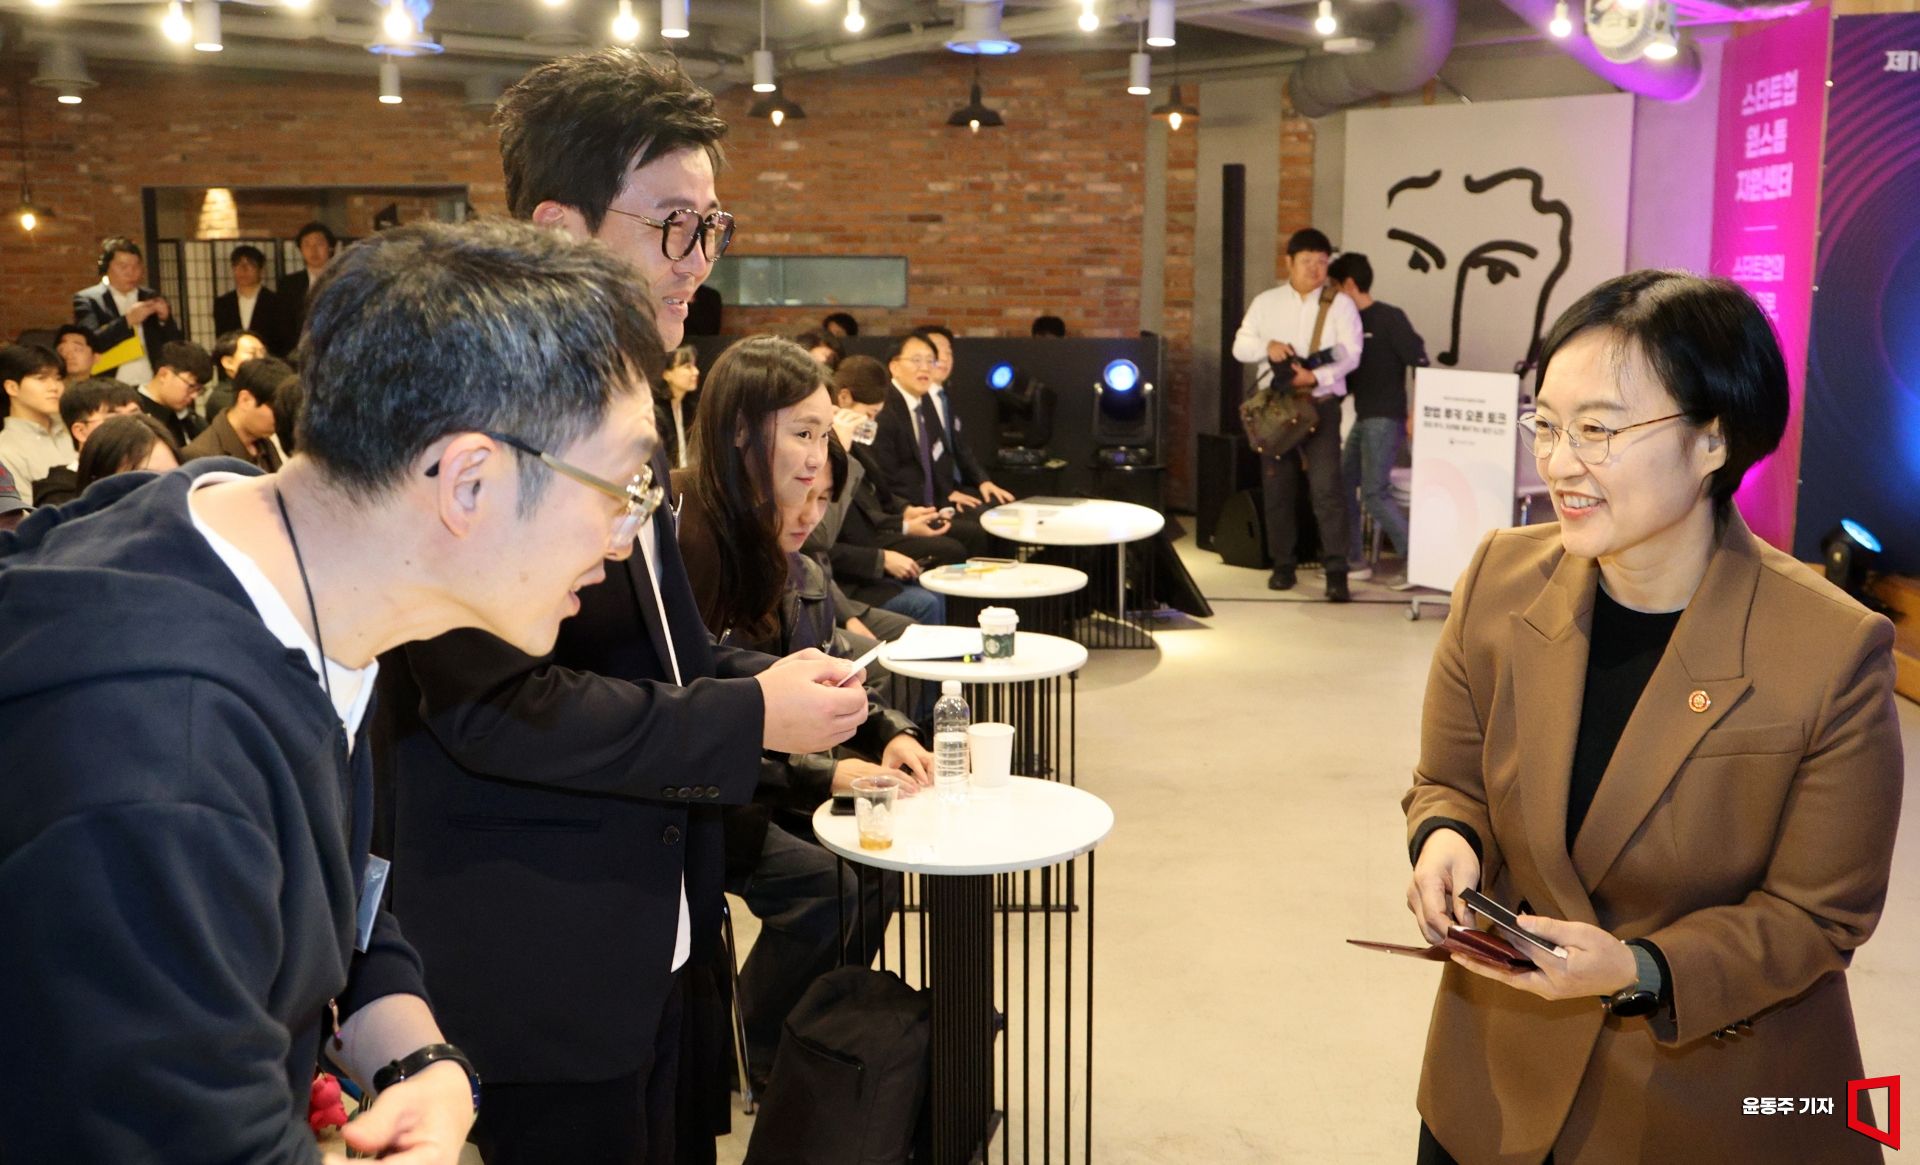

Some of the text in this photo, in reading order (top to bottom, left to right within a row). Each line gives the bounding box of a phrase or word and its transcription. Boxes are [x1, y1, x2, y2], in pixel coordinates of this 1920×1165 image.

[1740, 69, 1799, 115] 스타트업
[1745, 119, 1788, 159] 원스톱
[1734, 163, 1794, 202] 지원센터
